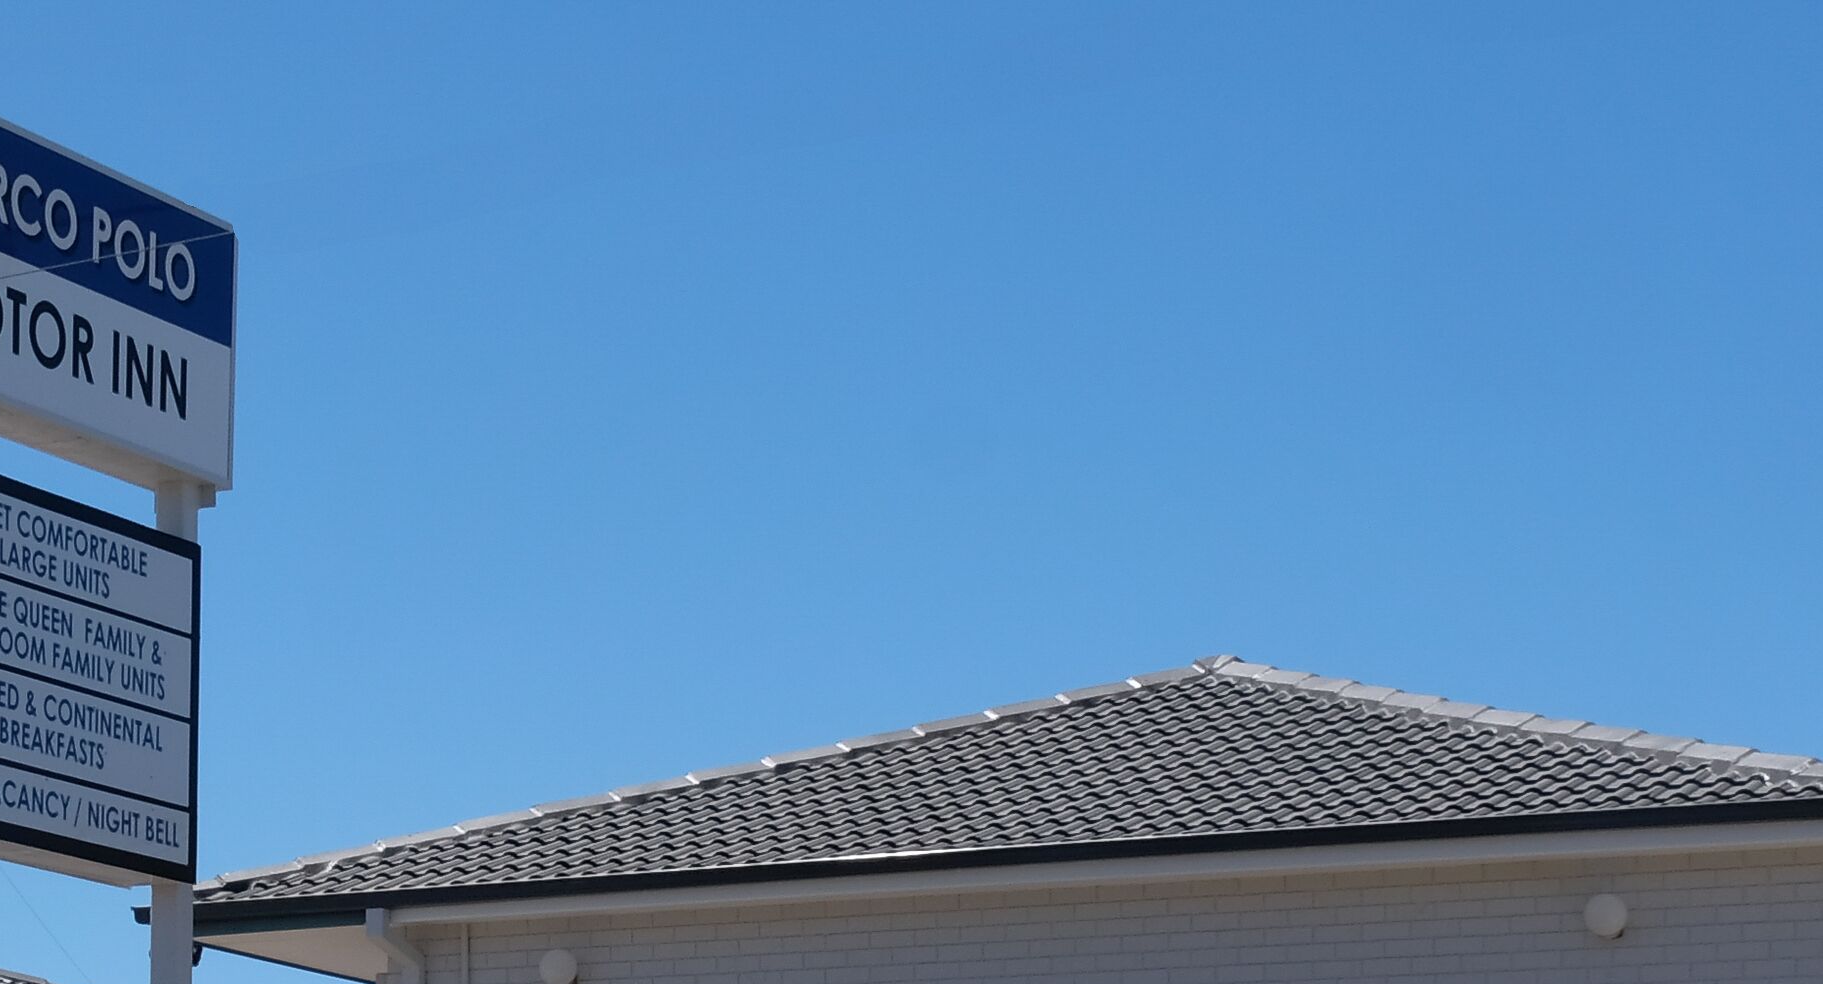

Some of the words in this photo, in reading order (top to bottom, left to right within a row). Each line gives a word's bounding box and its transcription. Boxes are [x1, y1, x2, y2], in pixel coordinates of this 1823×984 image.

[92, 206, 196, 301] POLO
[112, 330, 188, 421] INN
[0, 538, 57, 582] LARGE
[63, 561, 110, 599] UNITS
[16, 510, 148, 577] COMFORTABLE
[13, 596, 73, 638] QUEEN
[85, 617, 146, 660] FAMILY
[151, 640, 162, 665] &
[52, 642, 115, 685] FAMILY
[120, 662, 165, 701] UNITS
[0, 716, 105, 770] BREAKFASTS
[25, 690, 37, 717] &
[43, 694, 163, 752] CONTINENTAL
[88, 801, 140, 839] NIGHT
[145, 815, 179, 848] BELL
